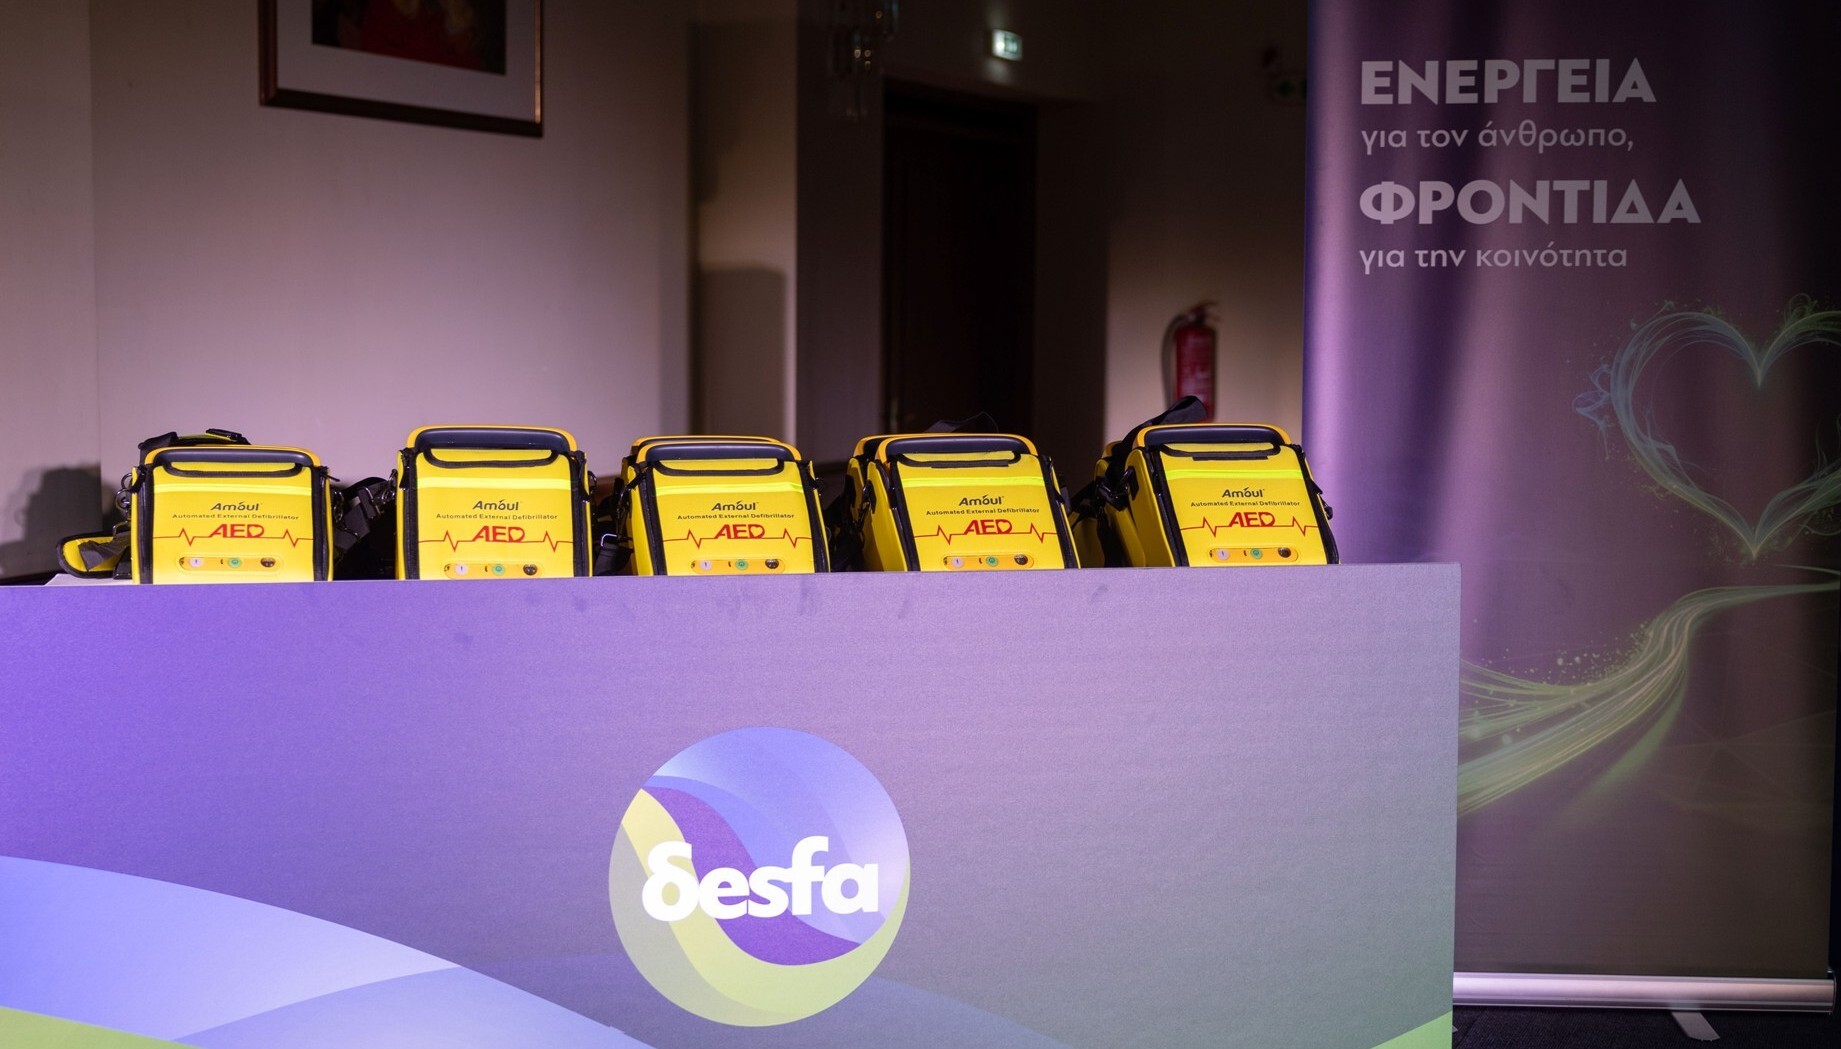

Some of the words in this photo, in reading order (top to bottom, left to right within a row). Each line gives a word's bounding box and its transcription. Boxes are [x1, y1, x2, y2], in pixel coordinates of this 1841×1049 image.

[1361, 57, 1657, 105] ΕΝΕΡΓΕΙΑ
[1361, 130, 1408, 155] για
[1417, 130, 1468, 149] τον
[1478, 120, 1634, 155] άνθρωπο,
[1359, 178, 1701, 226] ΦΡΟΝΤΙΔΑ
[1359, 249, 1405, 275] για
[1414, 249, 1467, 269] την
[1475, 241, 1628, 269] κοινότητα
[964, 519, 1012, 535] AED
[1228, 512, 1276, 527] AED
[208, 524, 265, 538] AED
[472, 526, 526, 542] AED
[714, 524, 766, 540] AED
